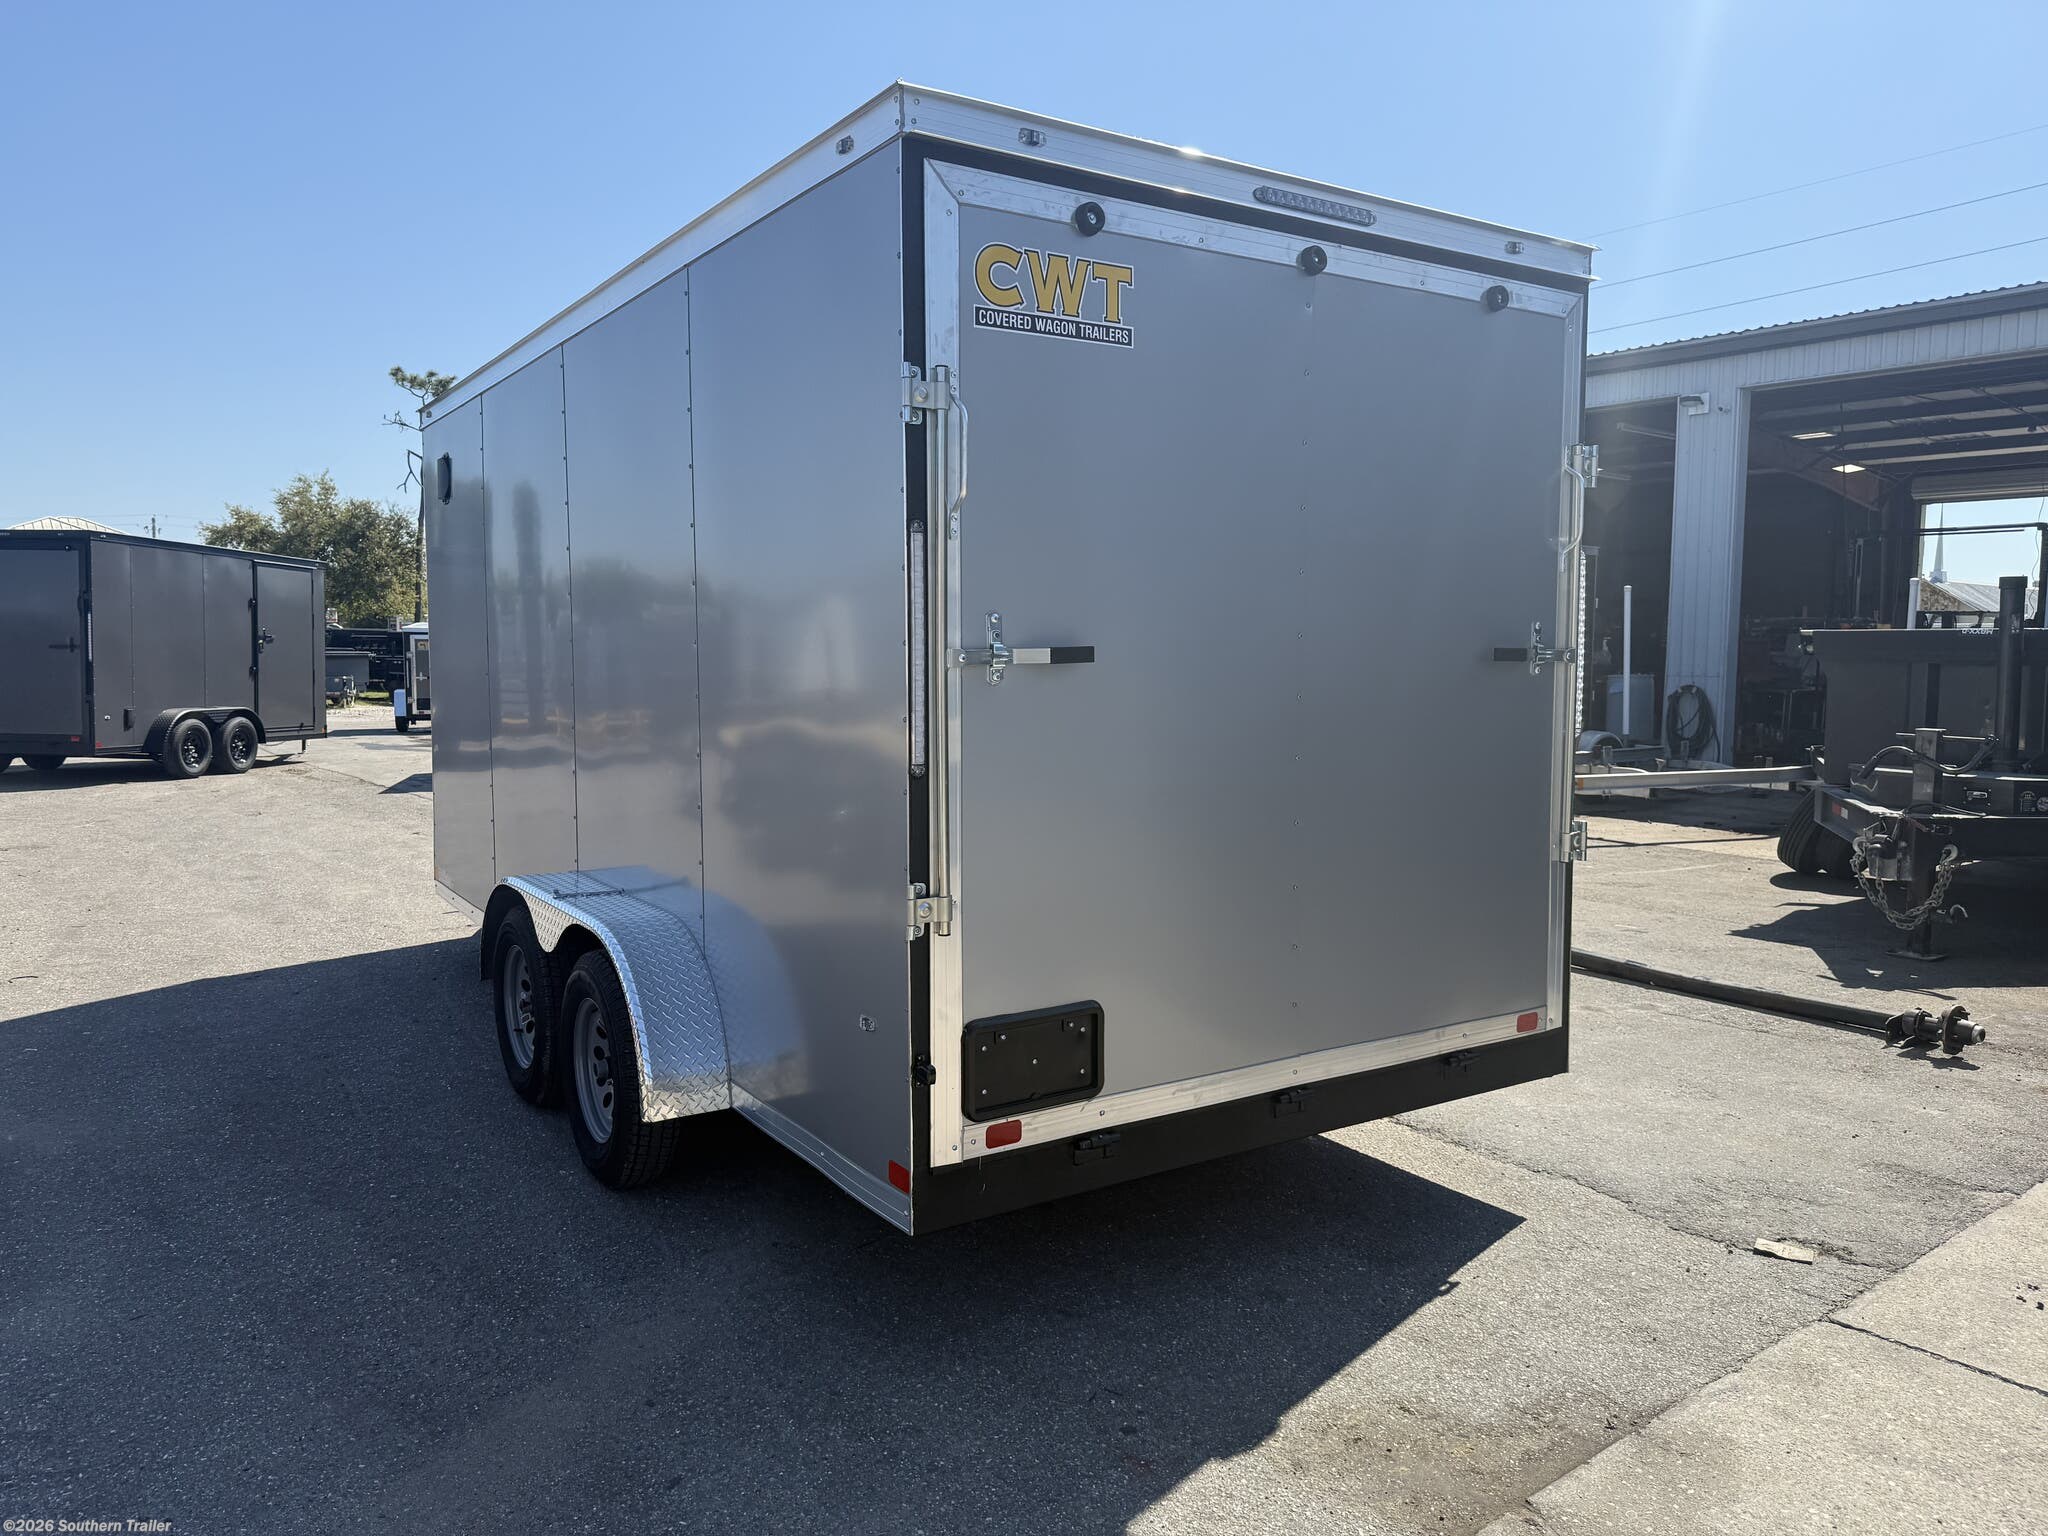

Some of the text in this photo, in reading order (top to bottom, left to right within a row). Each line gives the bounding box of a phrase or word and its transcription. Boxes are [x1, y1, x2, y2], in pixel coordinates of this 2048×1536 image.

[974, 242, 1134, 324] CWT
[979, 309, 1129, 344] COVERED WAGON TRAILERS
